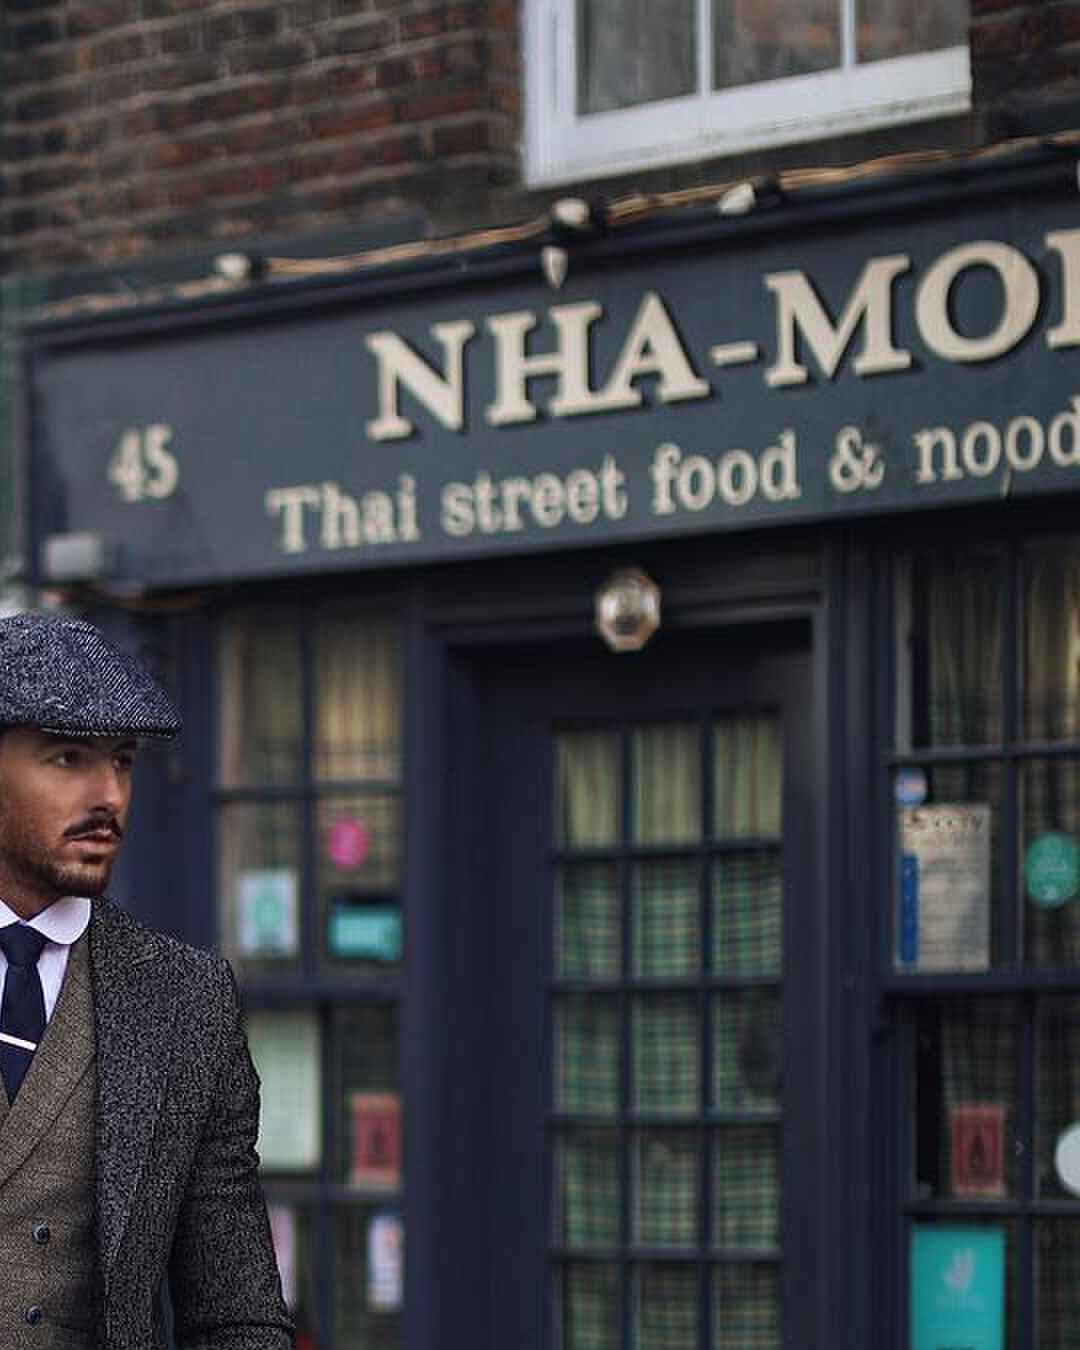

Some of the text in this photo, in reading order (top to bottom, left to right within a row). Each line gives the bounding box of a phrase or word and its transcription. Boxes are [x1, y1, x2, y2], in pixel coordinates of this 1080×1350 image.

[108, 422, 179, 502] 45
[265, 473, 421, 553] Thai
[440, 453, 628, 538] street
[650, 427, 802, 515] food
[829, 424, 885, 493] &
